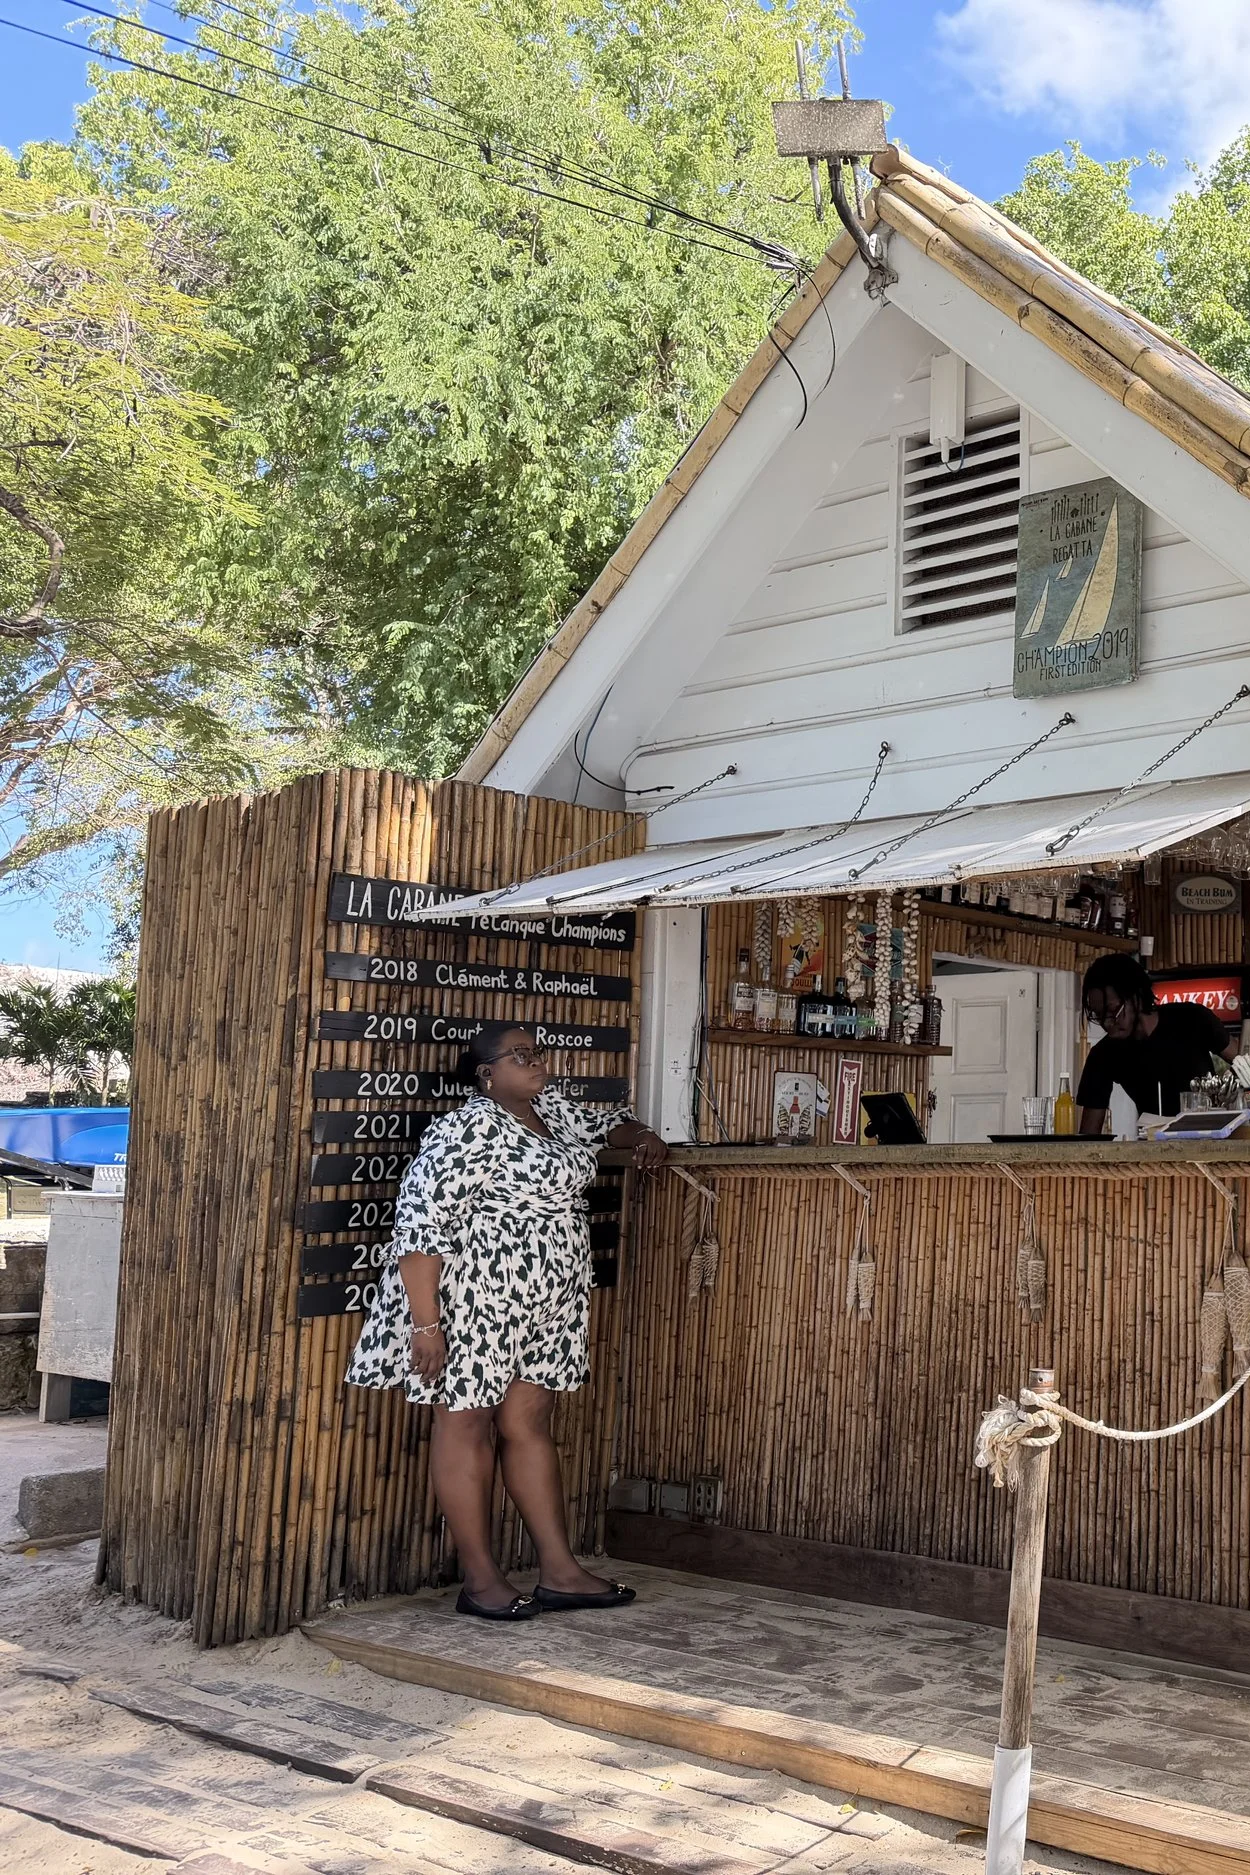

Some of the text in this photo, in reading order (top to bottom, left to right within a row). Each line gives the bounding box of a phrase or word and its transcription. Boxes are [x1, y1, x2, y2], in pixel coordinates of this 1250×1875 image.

[1050, 515, 1098, 542] LA CABANE
[1052, 539, 1093, 565] REGATTA
[1017, 627, 1129, 674] CHAMPION 2019
[1039, 659, 1102, 681] FIRST EDITION
[1181, 887, 1234, 897] BEACH BUM
[346, 880, 373, 919] LA
[470, 914, 546, 940] étanque
[551, 915, 627, 947] Champions
[370, 957, 598, 996] 2018 Clément & Raphaël
[1156, 989, 1231, 1010] ANKEY
[363, 1014, 418, 1041] 2019
[535, 1025, 594, 1047] Roscoe
[357, 1072, 420, 1096] 2020
[431, 1075, 478, 1098] Jule
[353, 1113, 411, 1139] 2021
[347, 1201, 394, 1228] 202
[351, 1243, 383, 1270] 20
[344, 1282, 379, 1312] 20
